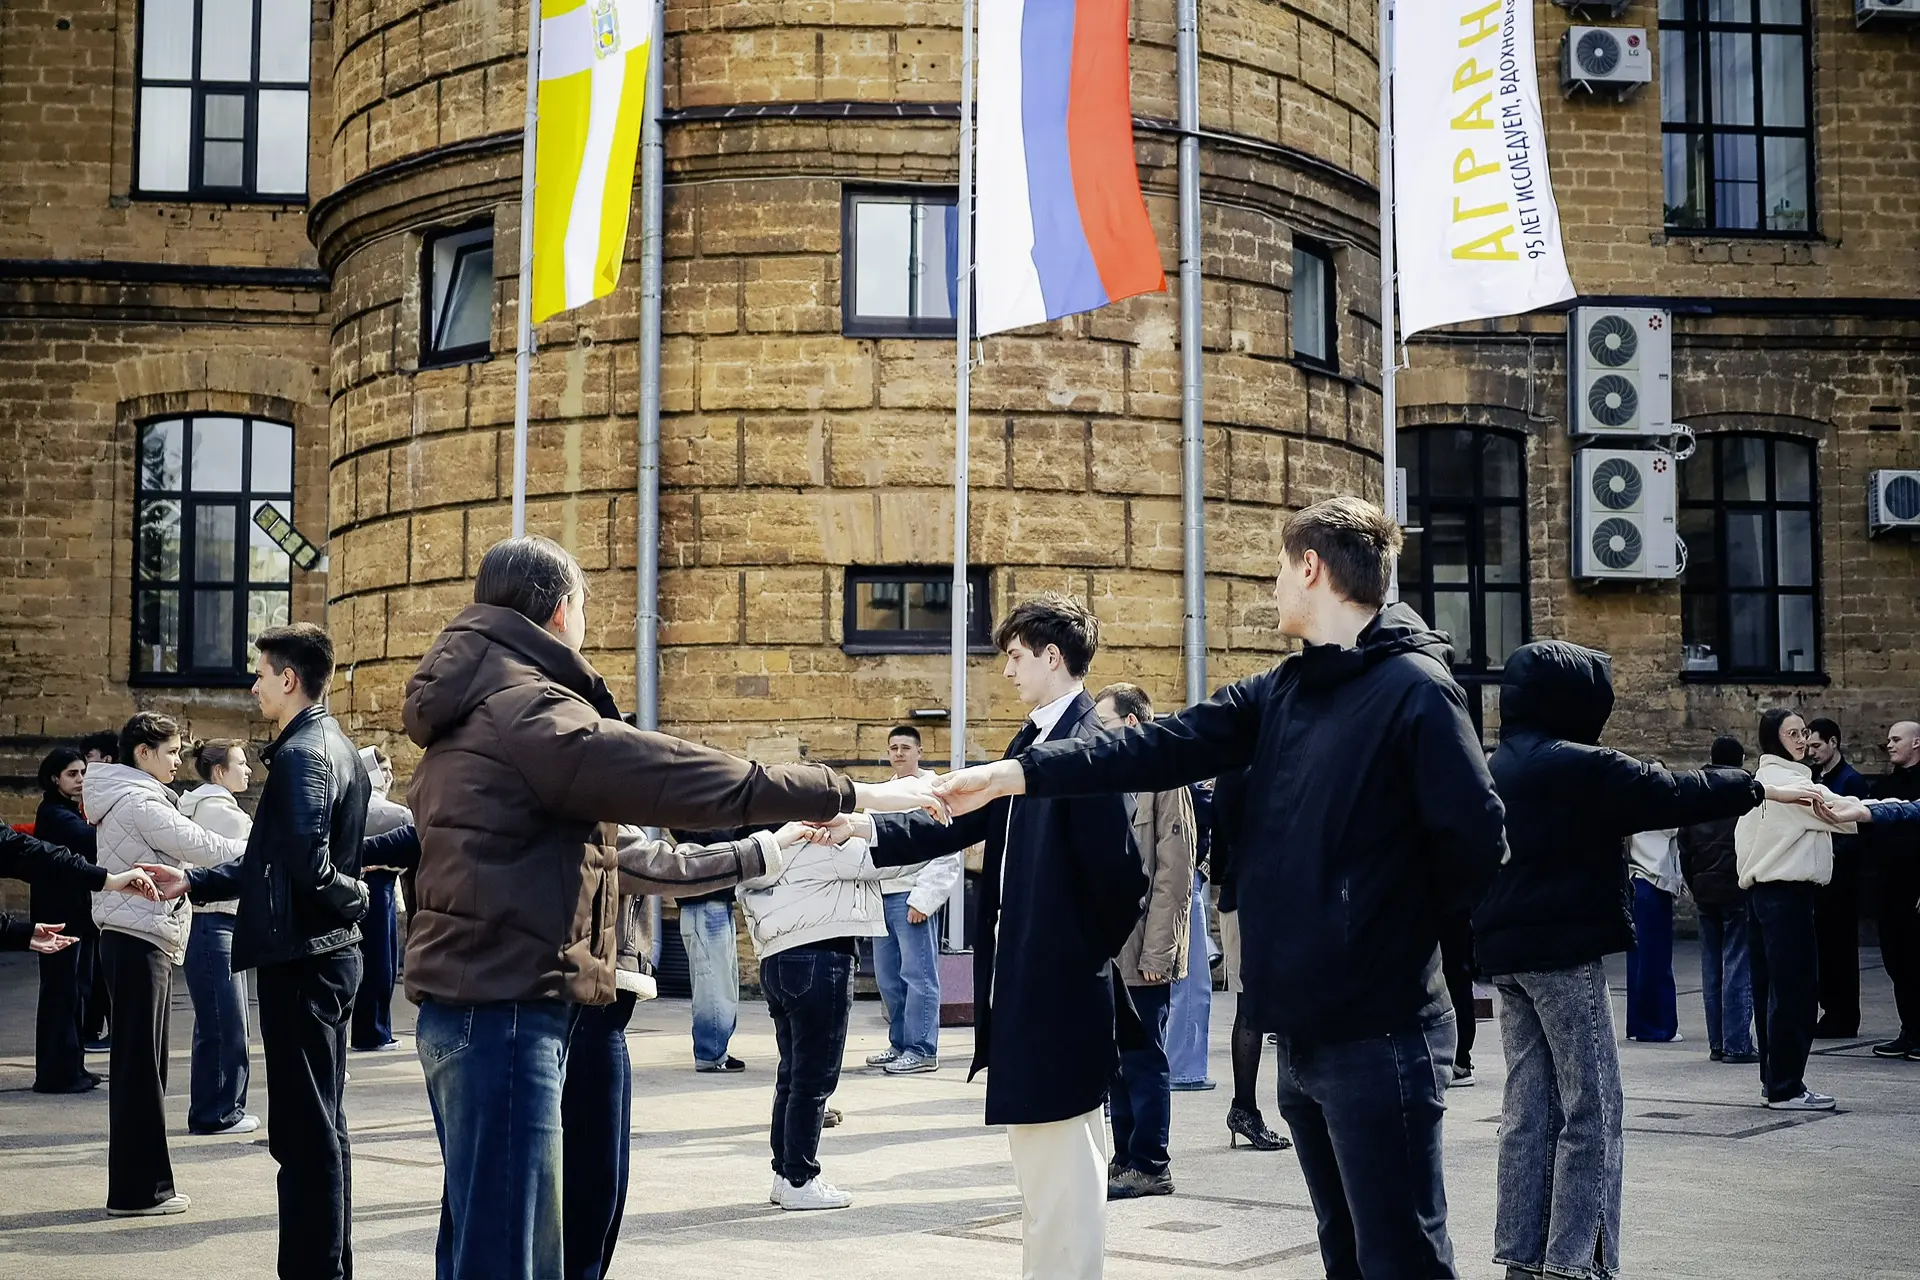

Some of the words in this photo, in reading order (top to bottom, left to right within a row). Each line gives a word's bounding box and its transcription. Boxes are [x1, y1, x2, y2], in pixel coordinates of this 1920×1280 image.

[1628, 49, 1640, 57] LG
[1501, 98, 1535, 202] ИССЛЕДУЕМ,
[1519, 208, 1542, 235] ЛЕТ
[1527, 239, 1546, 259] 95
